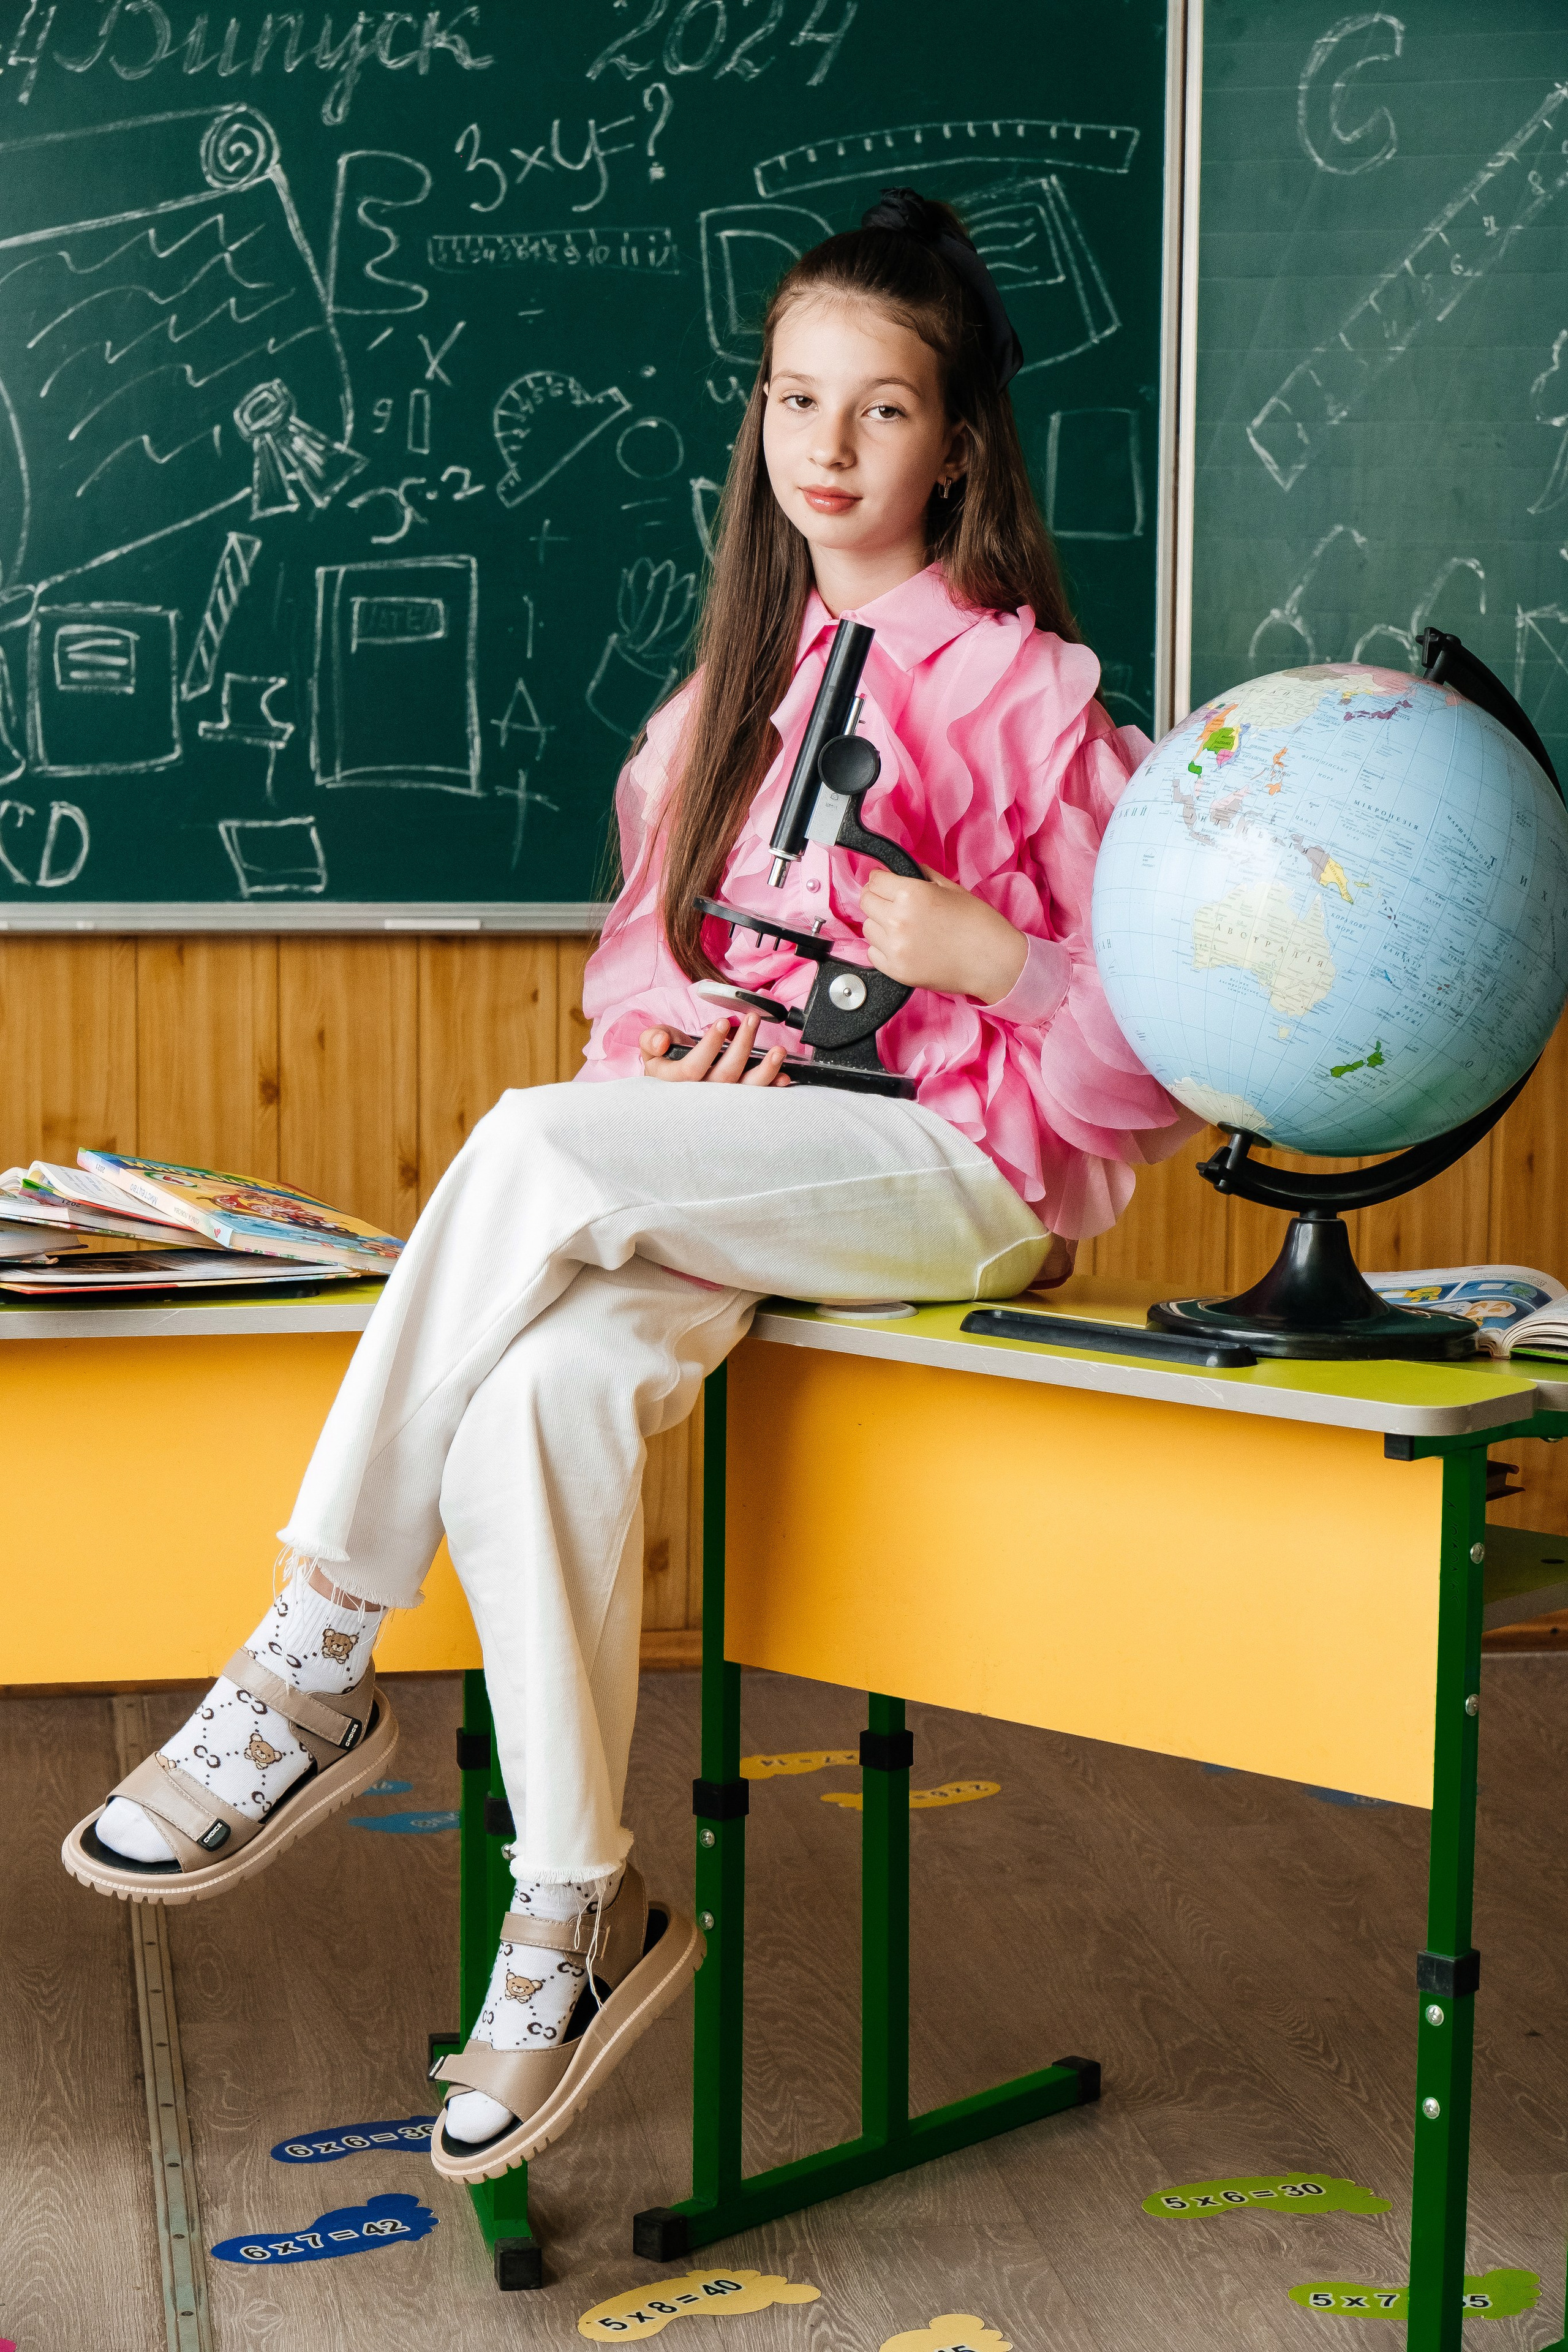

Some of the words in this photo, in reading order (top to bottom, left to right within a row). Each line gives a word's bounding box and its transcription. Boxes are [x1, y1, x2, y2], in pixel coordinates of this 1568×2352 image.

[586, 0, 859, 86] 2024
[1215, 922, 1325, 968] АВСТРАЛІЯ
[345, 1724, 358, 1747] CHOICE
[203, 1822, 223, 1844] CHOICE
